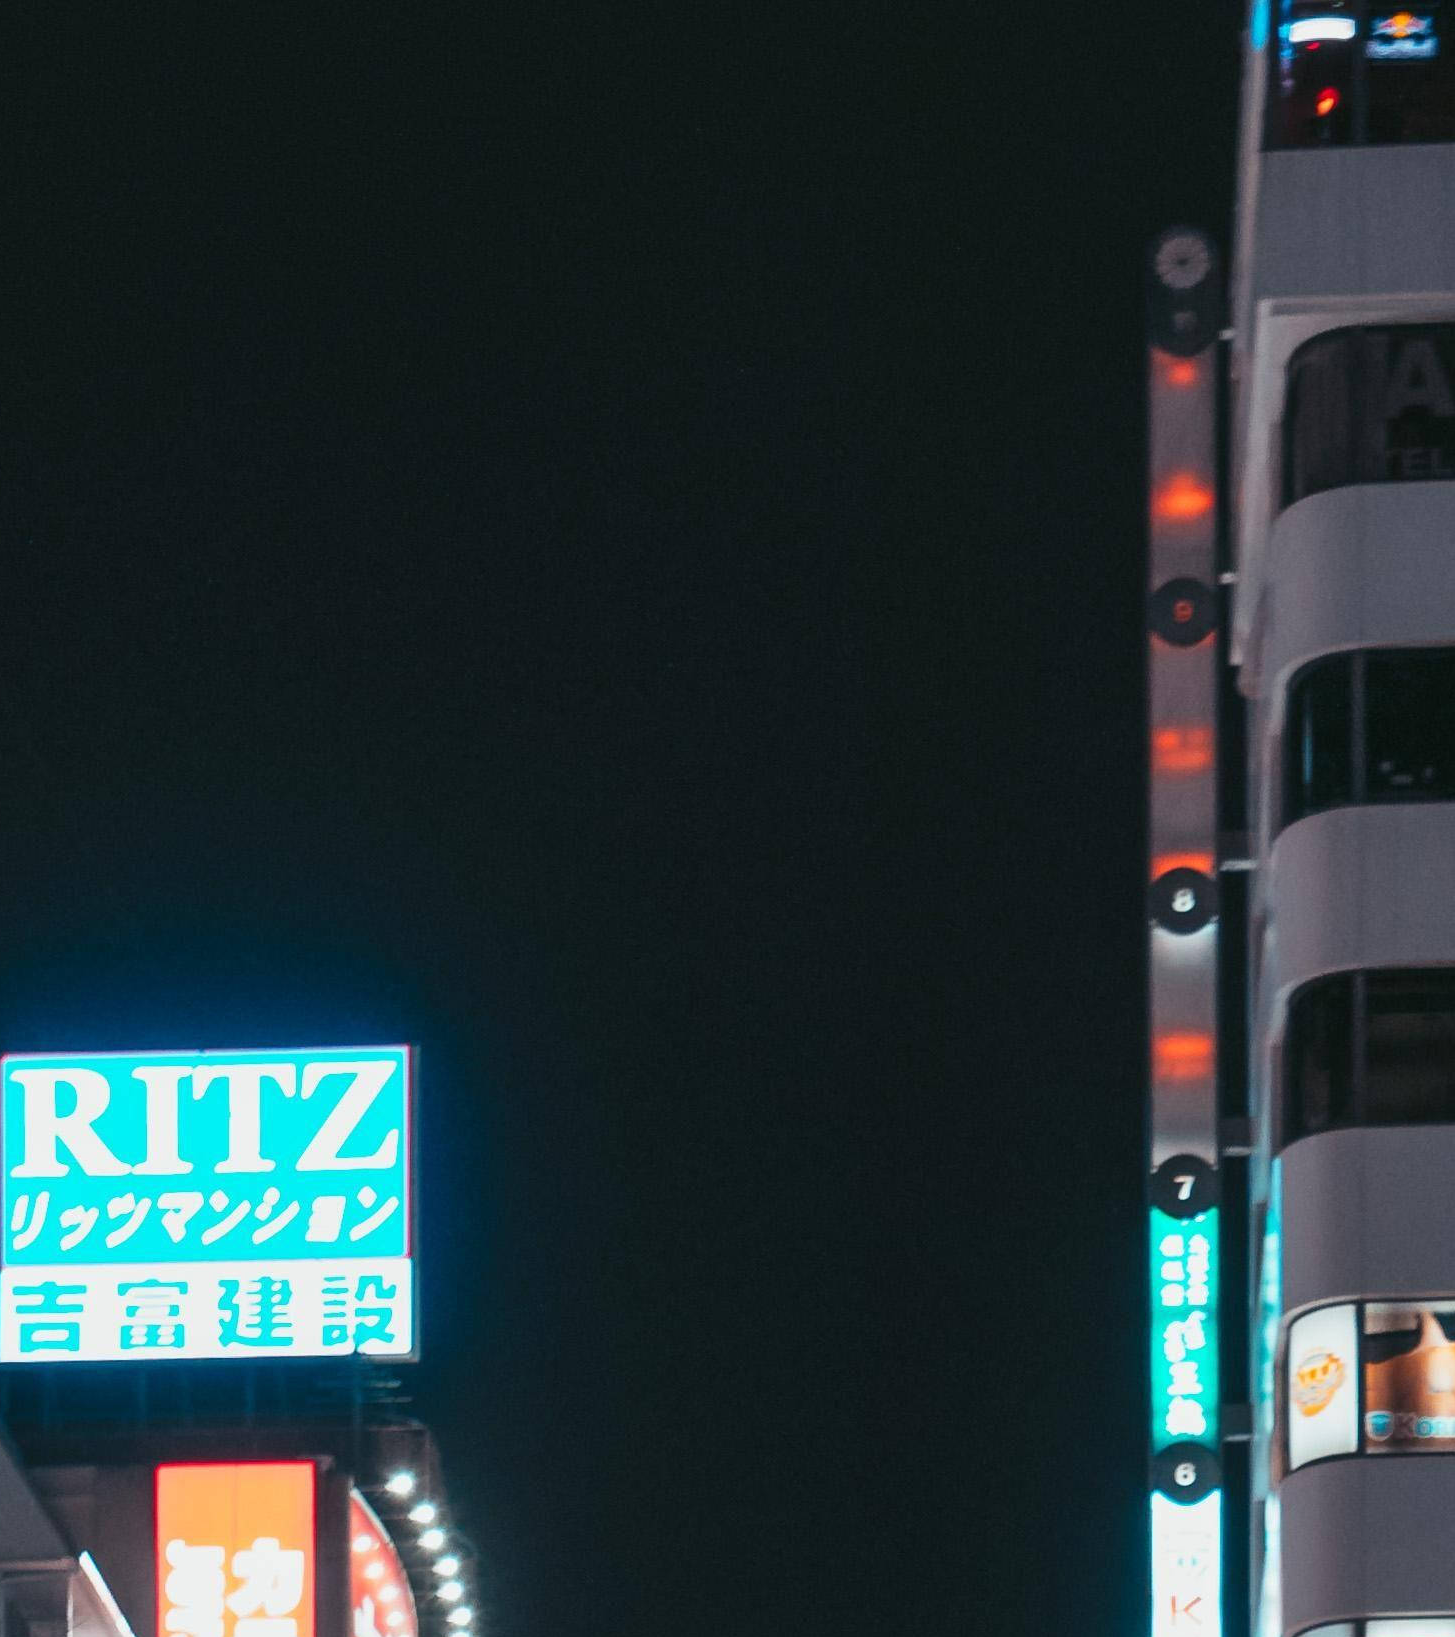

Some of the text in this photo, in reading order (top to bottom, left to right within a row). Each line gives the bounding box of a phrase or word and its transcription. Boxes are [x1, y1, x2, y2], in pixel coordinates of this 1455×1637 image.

[1172, 886, 1195, 914] 8
[10, 1060, 400, 1178] RITZ
[1172, 1175, 1197, 1200] 7
[10, 1186, 400, 1252] リッツマンション
[12, 1275, 397, 1353] 吉富建設
[1174, 1463, 1197, 1487] 6
